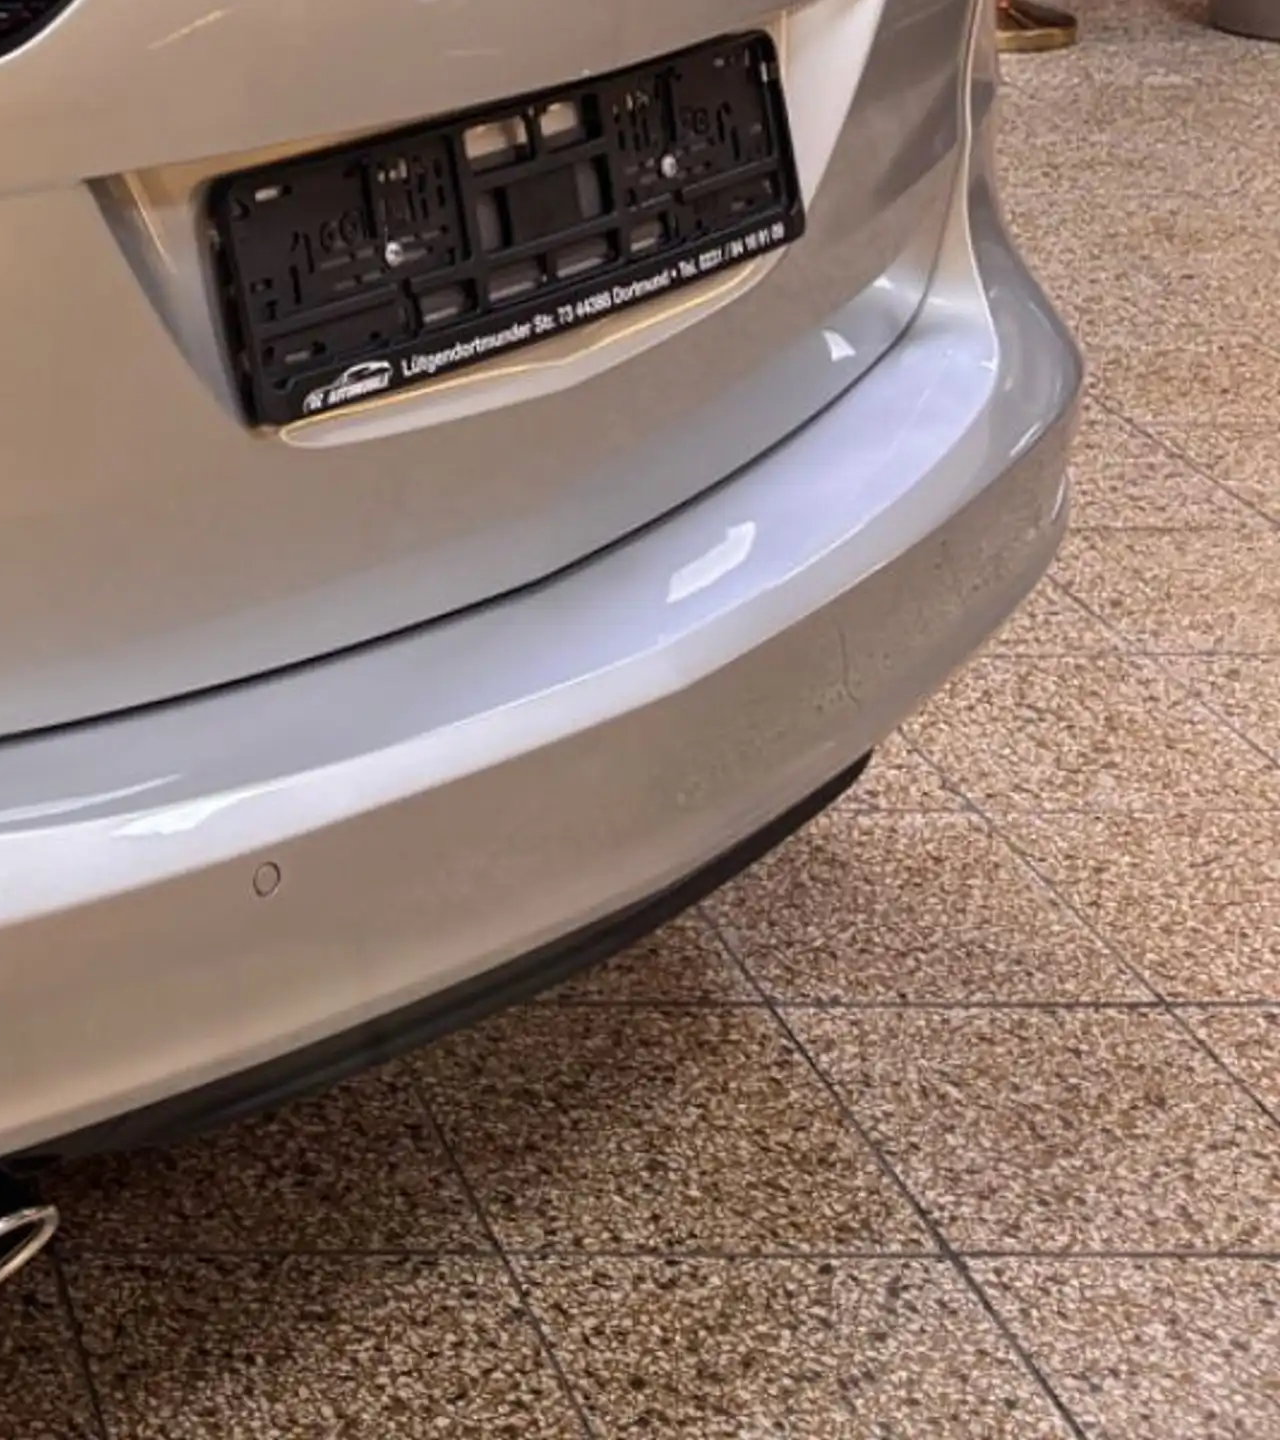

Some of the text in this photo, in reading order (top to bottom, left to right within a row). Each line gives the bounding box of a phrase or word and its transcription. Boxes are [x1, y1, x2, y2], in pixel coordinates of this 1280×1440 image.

[557, 304, 573, 324] 73
[612, 269, 671, 303] Dortmund
[678, 258, 698, 279] Tel.
